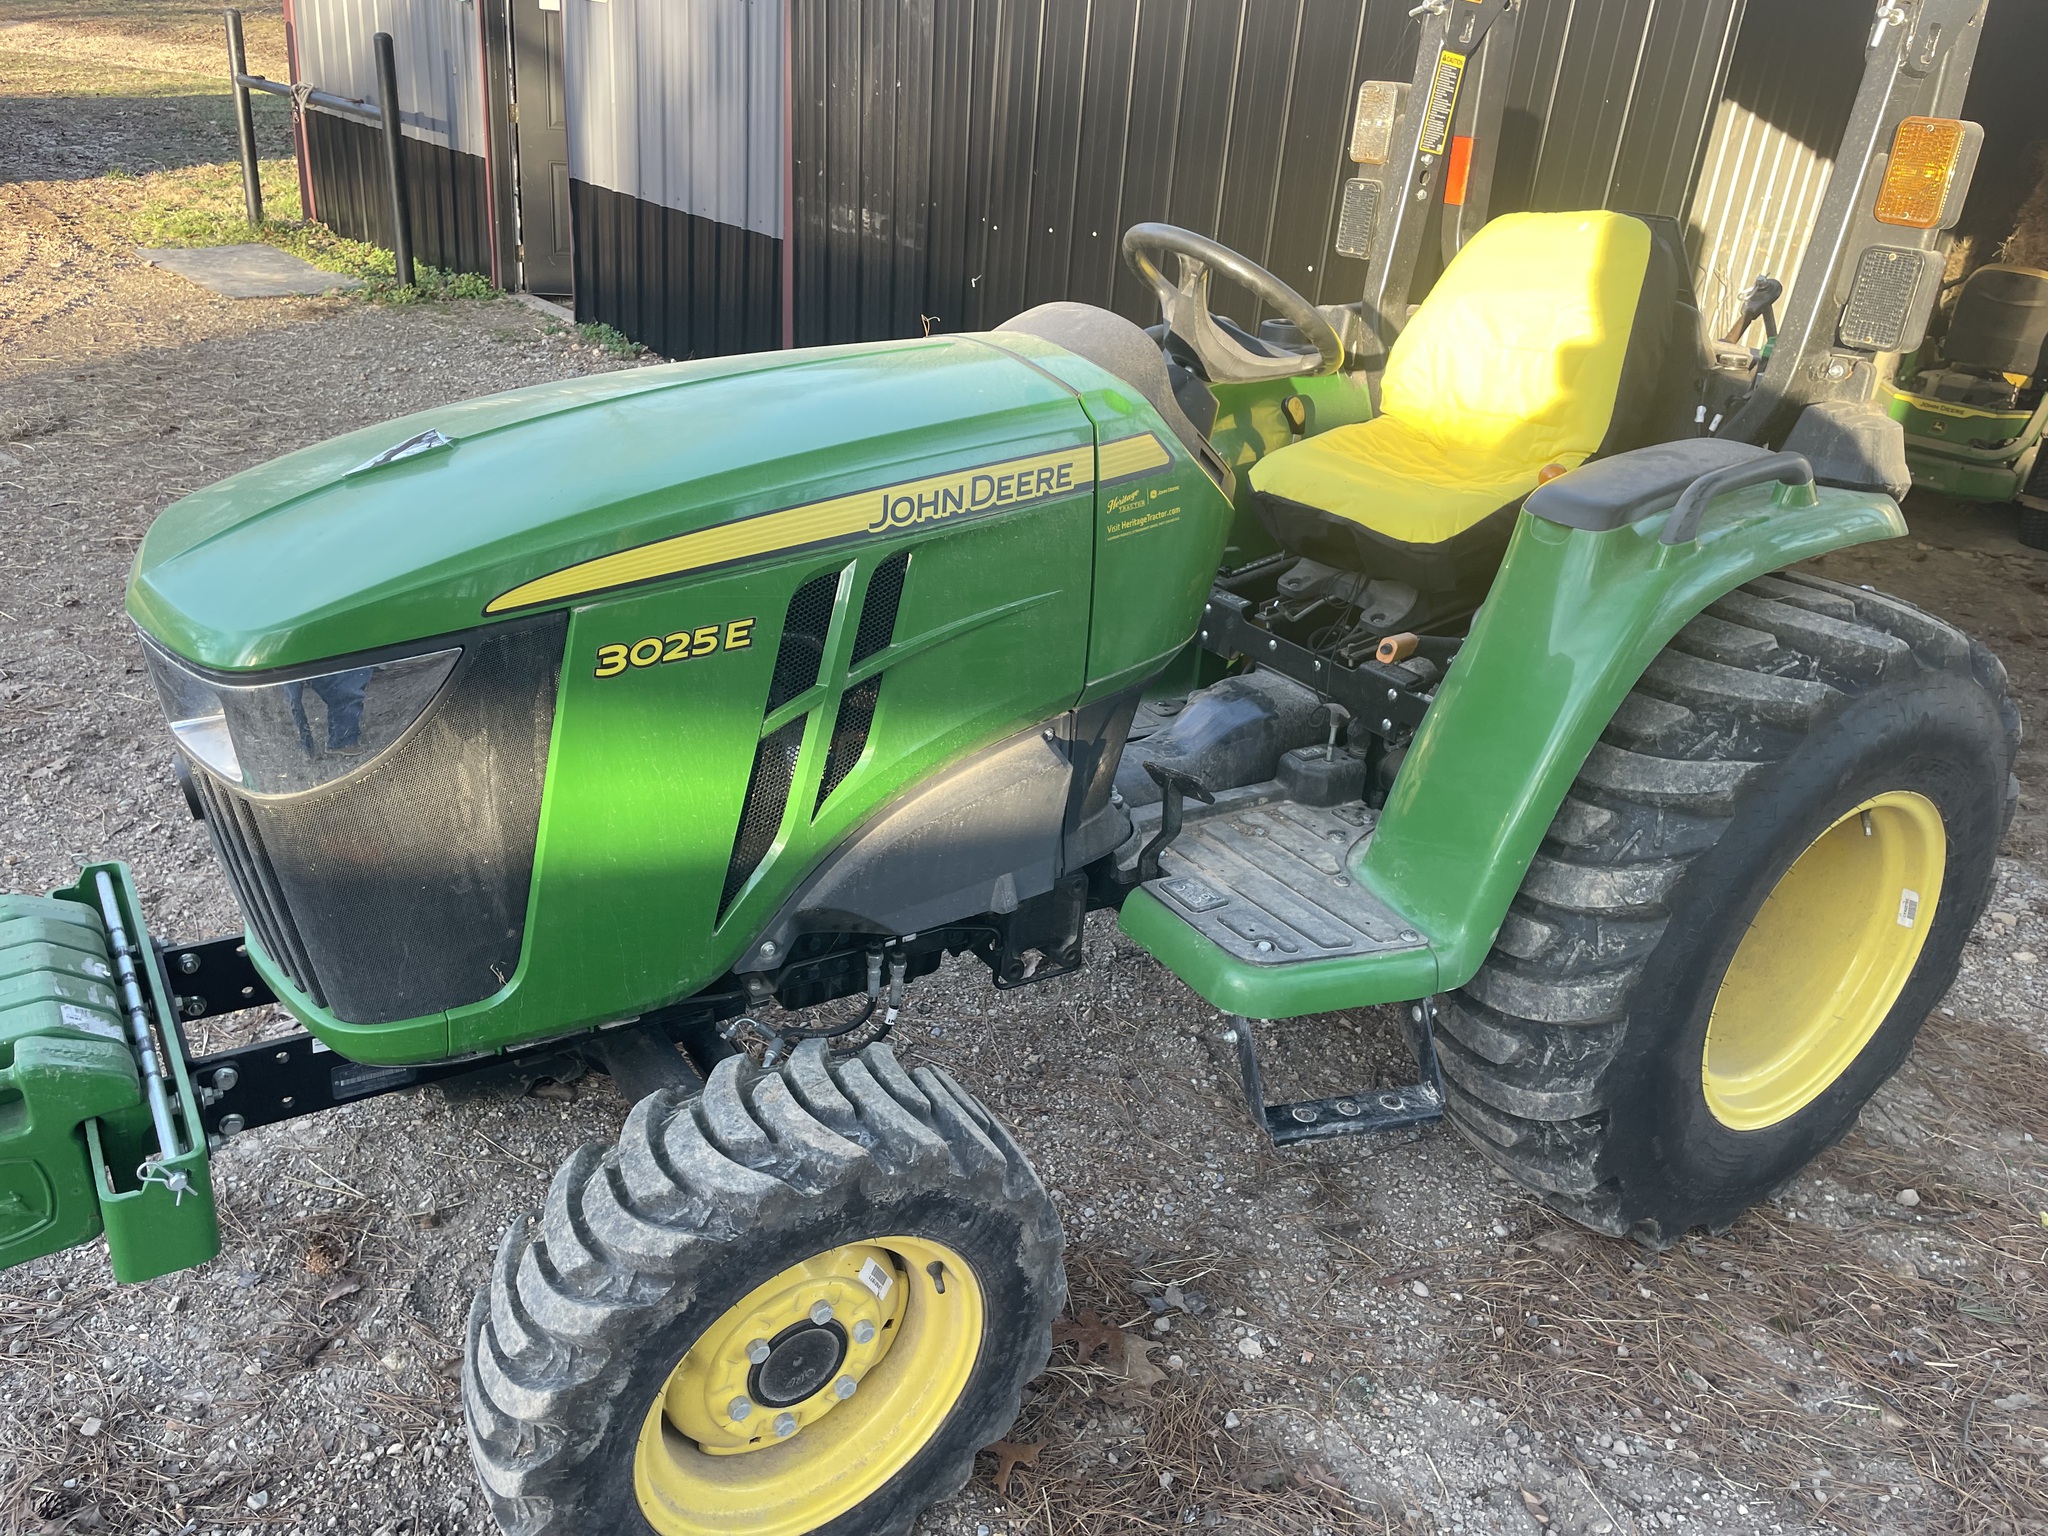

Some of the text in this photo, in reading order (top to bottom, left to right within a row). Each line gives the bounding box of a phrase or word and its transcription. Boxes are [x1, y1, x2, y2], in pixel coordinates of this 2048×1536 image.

[1446, 55, 1463, 66] CAUTION
[1920, 401, 1965, 415] JOHN DEERE
[868, 462, 1076, 532] JOHN DEERE
[1107, 489, 1139, 514] Heritage
[1107, 523, 1121, 533] Visit
[1121, 507, 1181, 529] HeritageTractor.com
[594, 616, 757, 678] 3025E
